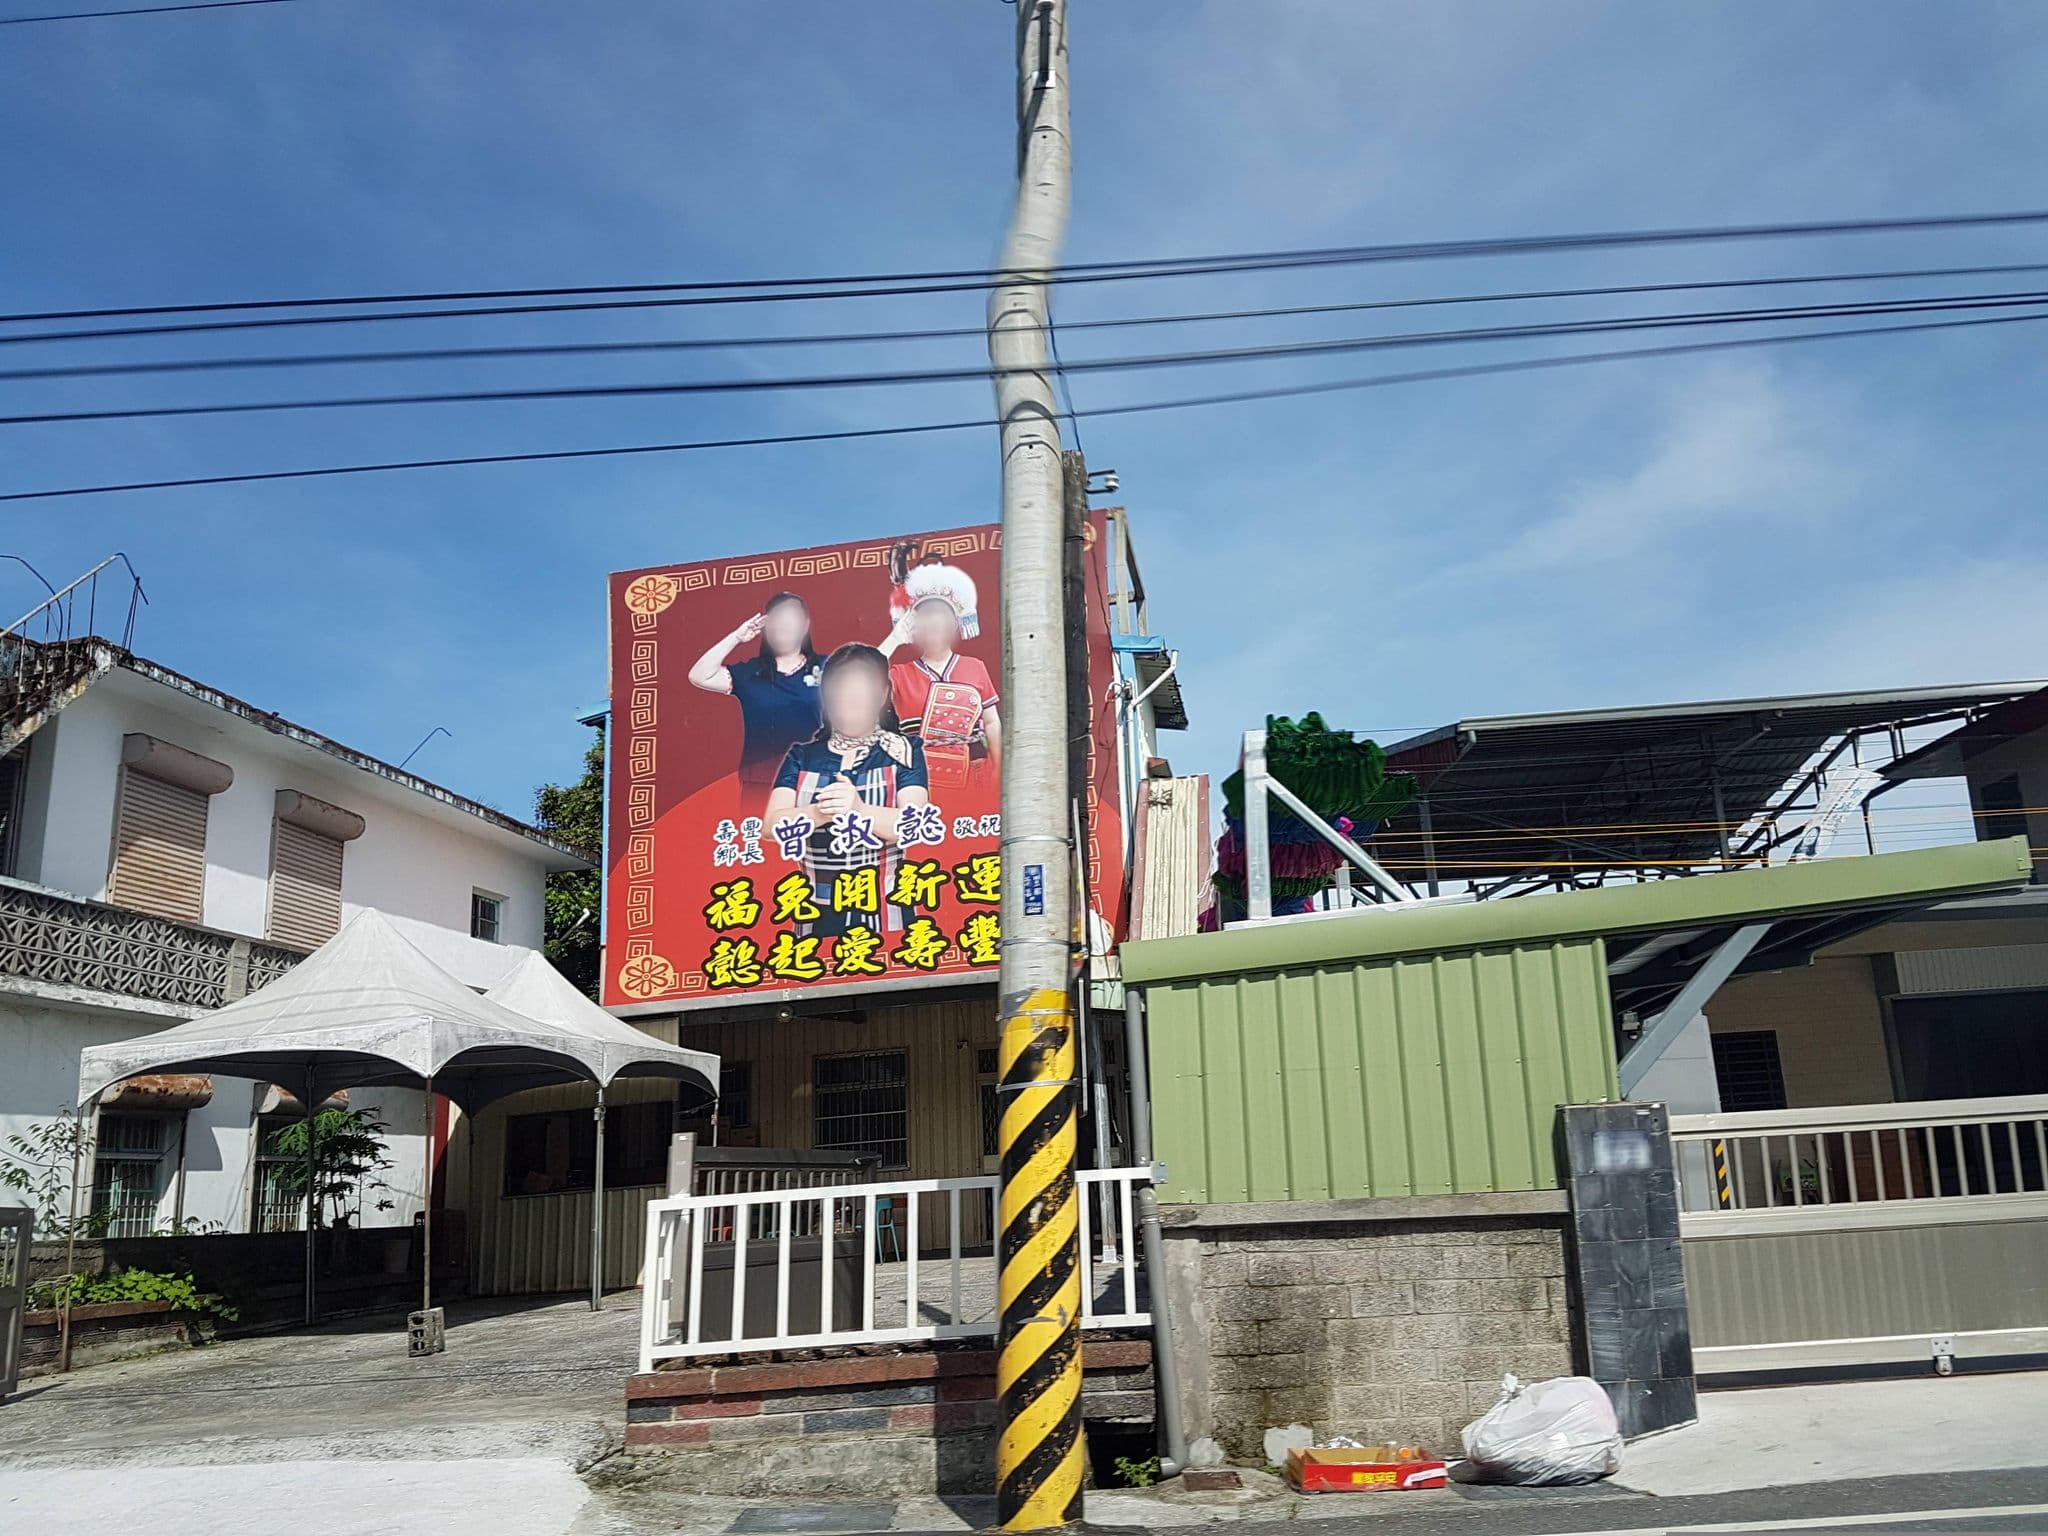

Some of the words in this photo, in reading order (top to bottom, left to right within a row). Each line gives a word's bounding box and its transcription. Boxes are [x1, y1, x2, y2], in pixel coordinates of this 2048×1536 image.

[714, 818, 762, 842] 壽豐
[774, 804, 943, 860] 曾淑懿
[954, 815, 1001, 838] 敬祝
[714, 842, 764, 866] 鄉長
